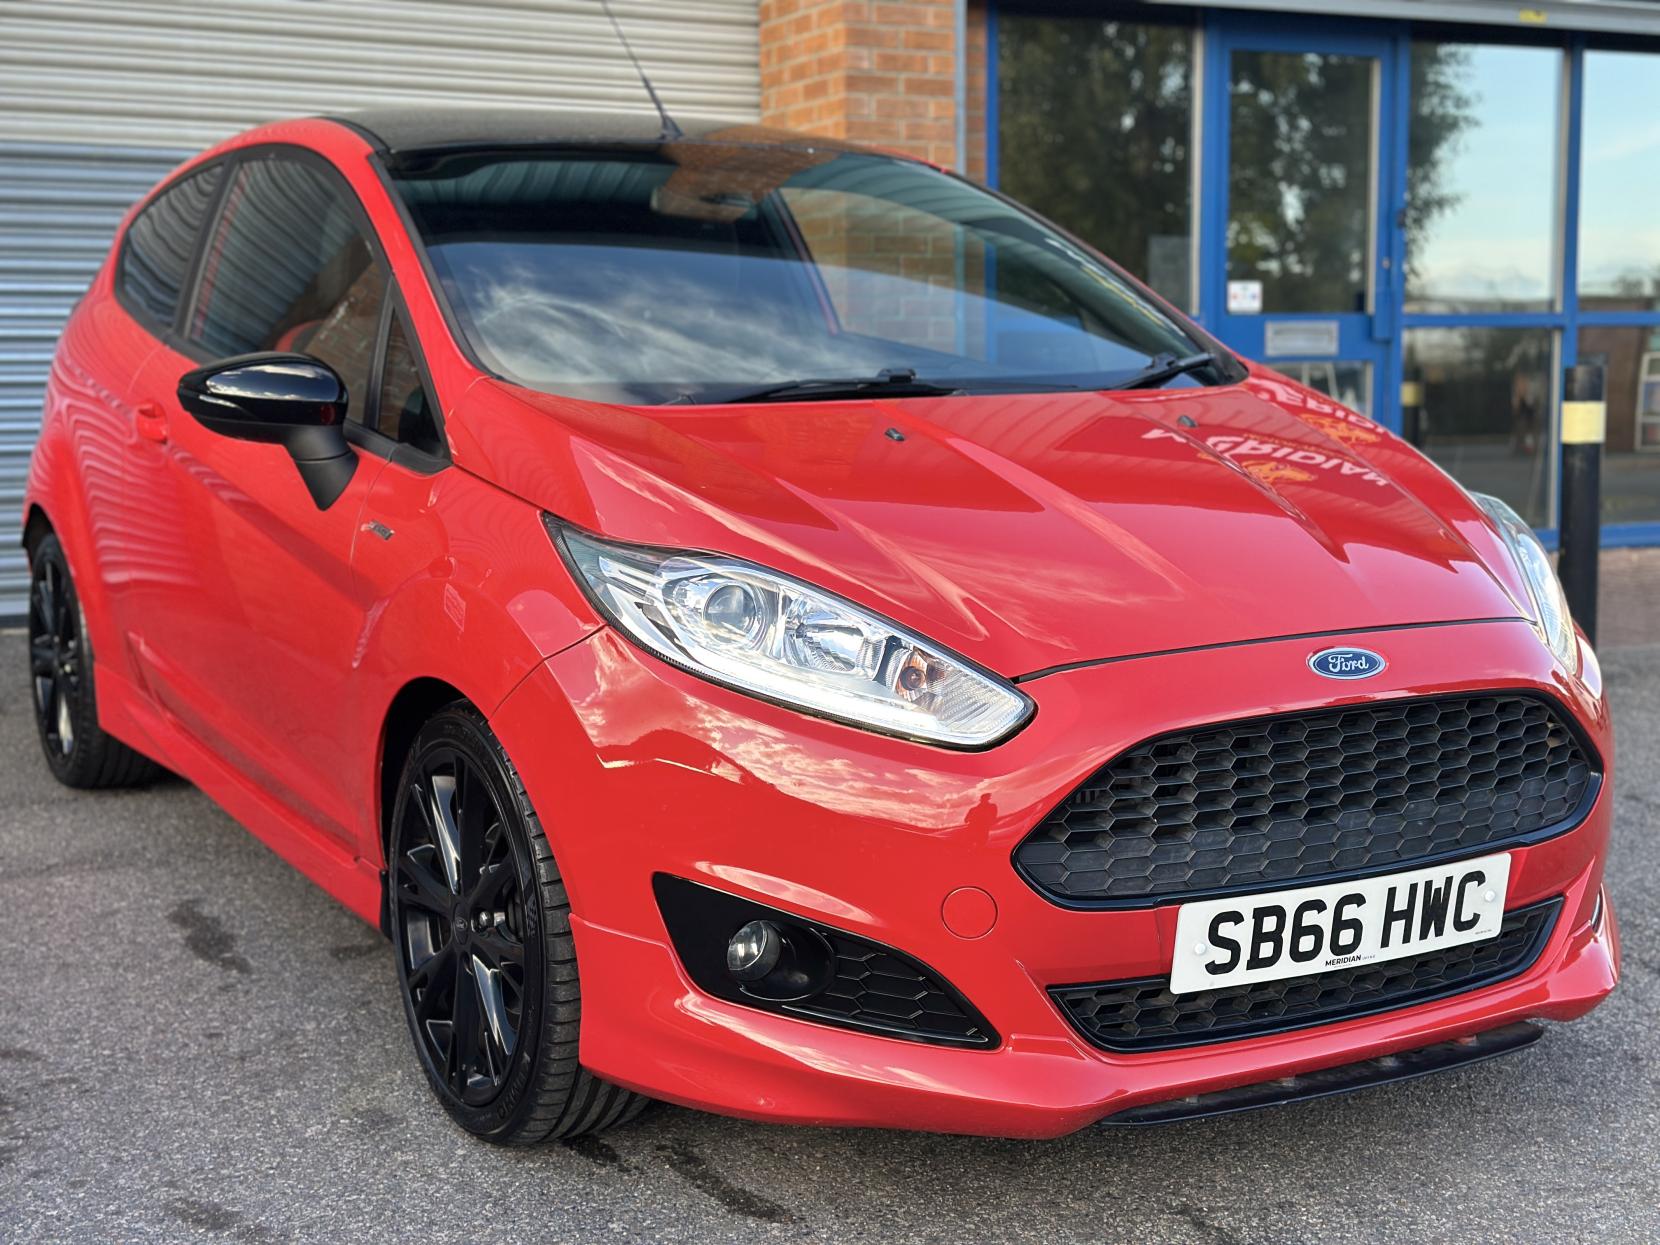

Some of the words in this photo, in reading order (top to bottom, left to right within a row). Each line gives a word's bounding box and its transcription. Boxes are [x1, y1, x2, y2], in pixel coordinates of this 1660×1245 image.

[1328, 653, 1369, 672] Ford
[1205, 893, 1366, 976] SB66
[1381, 870, 1486, 949] HWC
[1325, 954, 1361, 966] MERIDIAN
